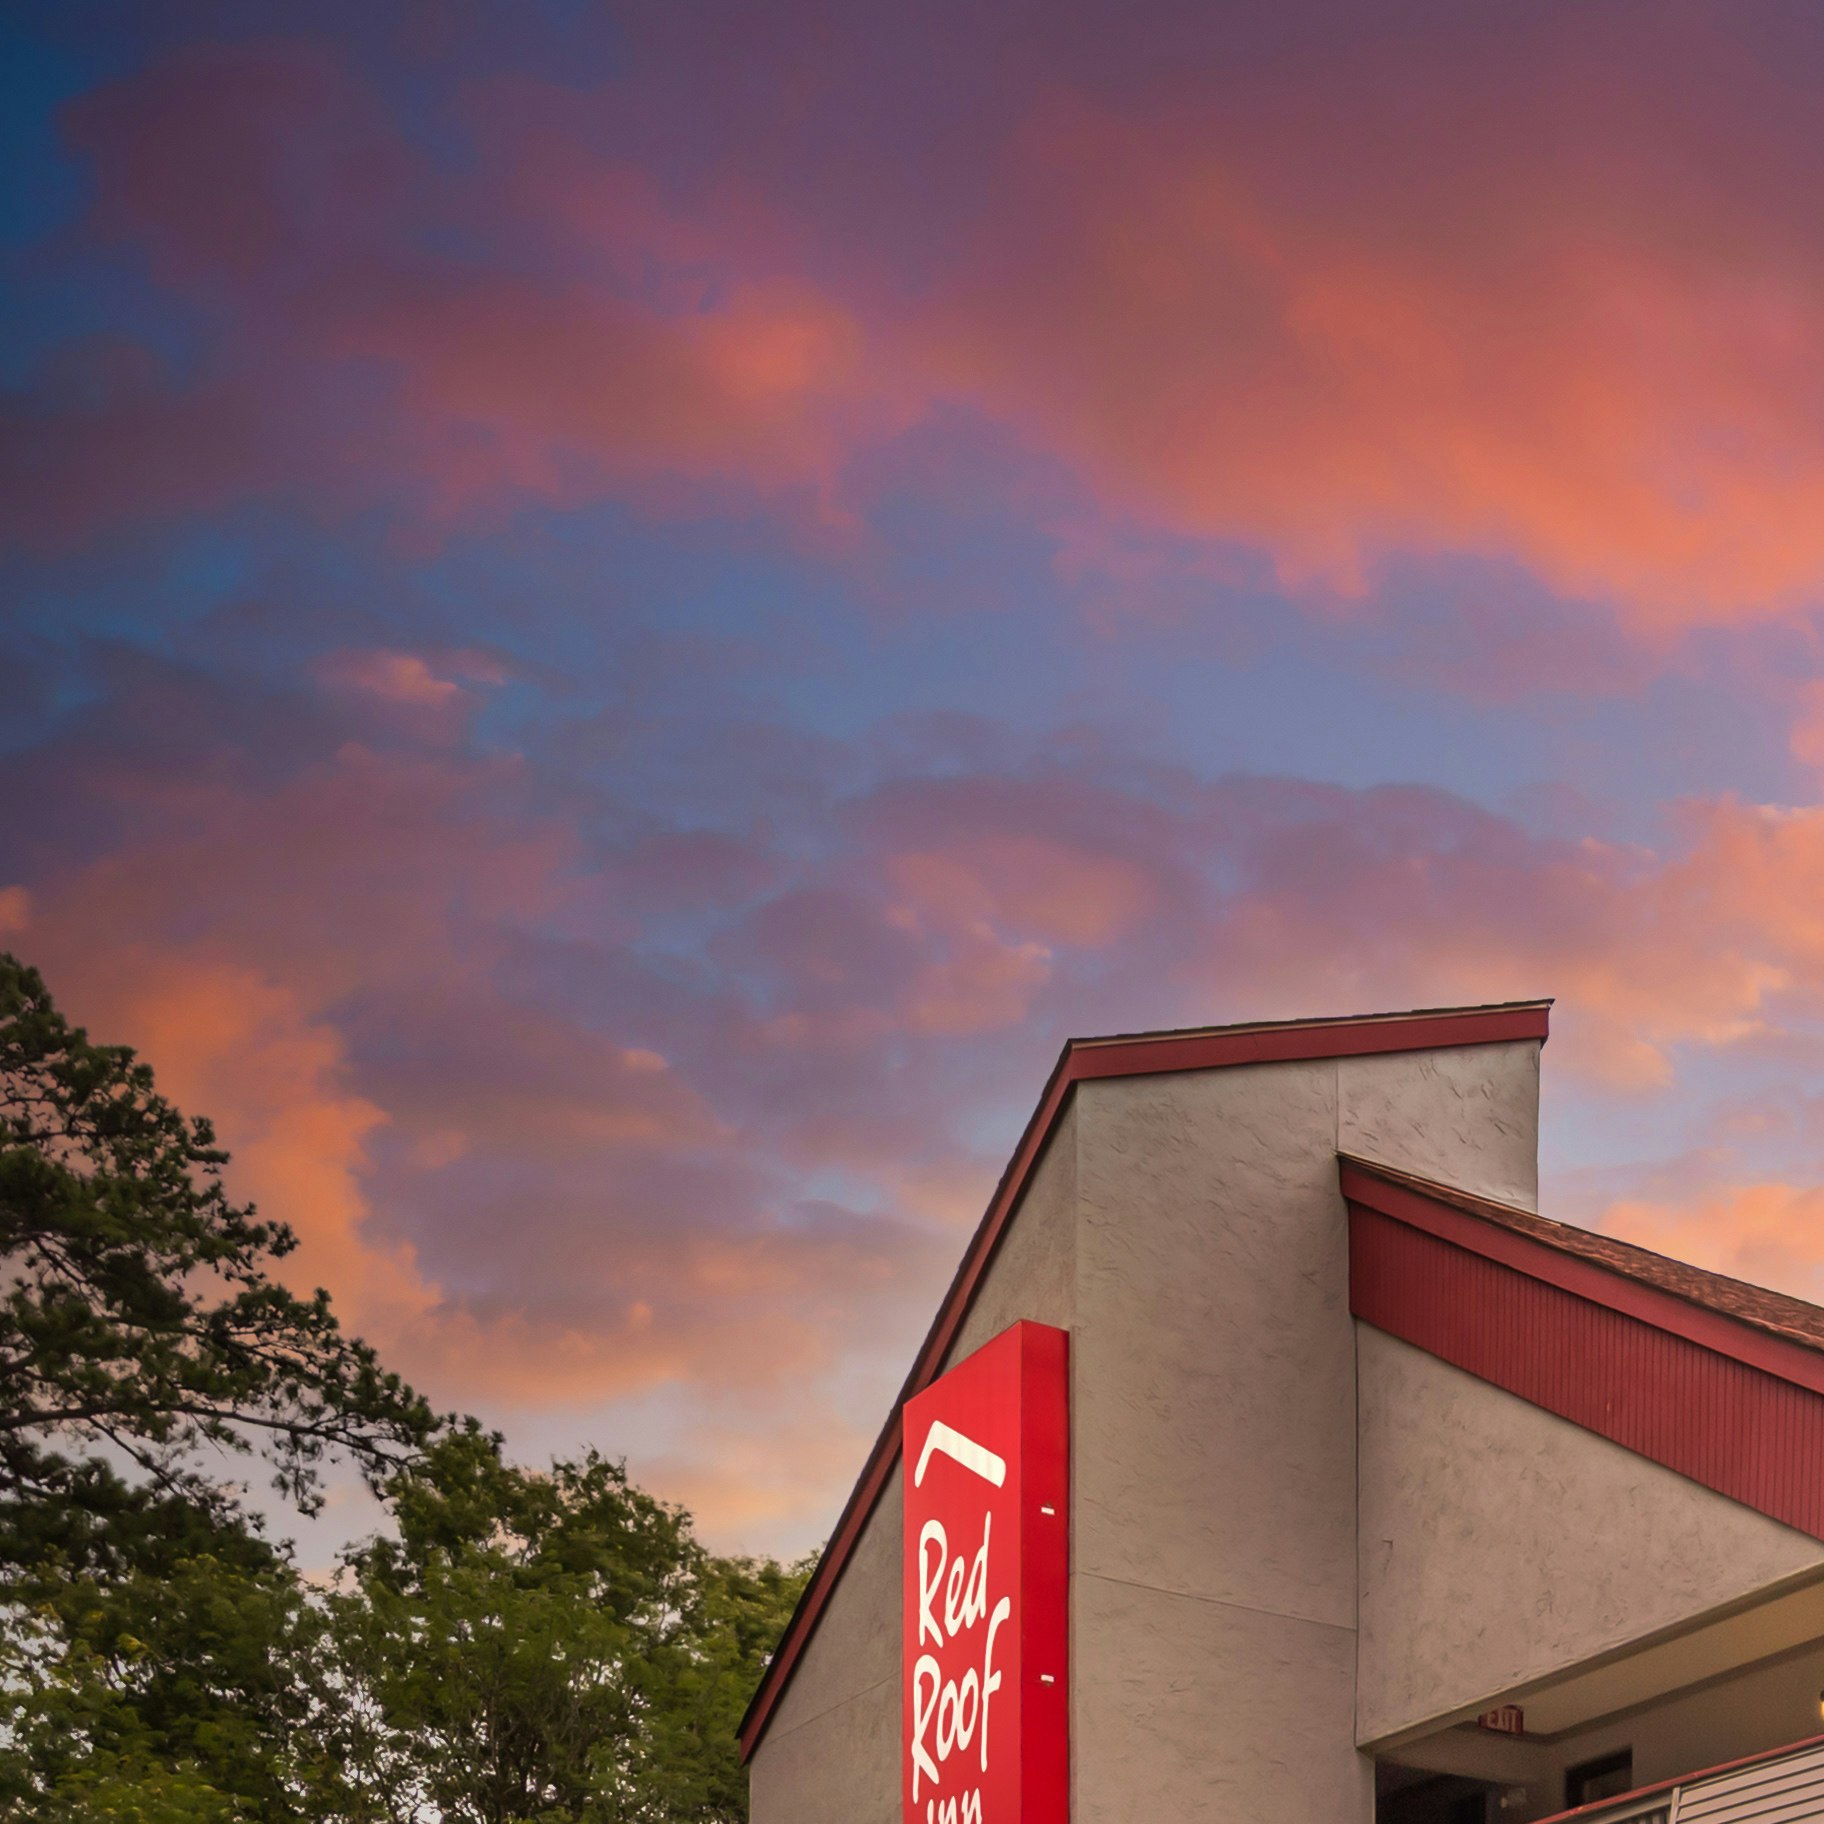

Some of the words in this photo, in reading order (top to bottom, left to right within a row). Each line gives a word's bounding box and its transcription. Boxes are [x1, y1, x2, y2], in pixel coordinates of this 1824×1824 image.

[919, 1511, 991, 1649] Red
[911, 1596, 1011, 1804] Roof
[1487, 1709, 1518, 1733] EXIT
